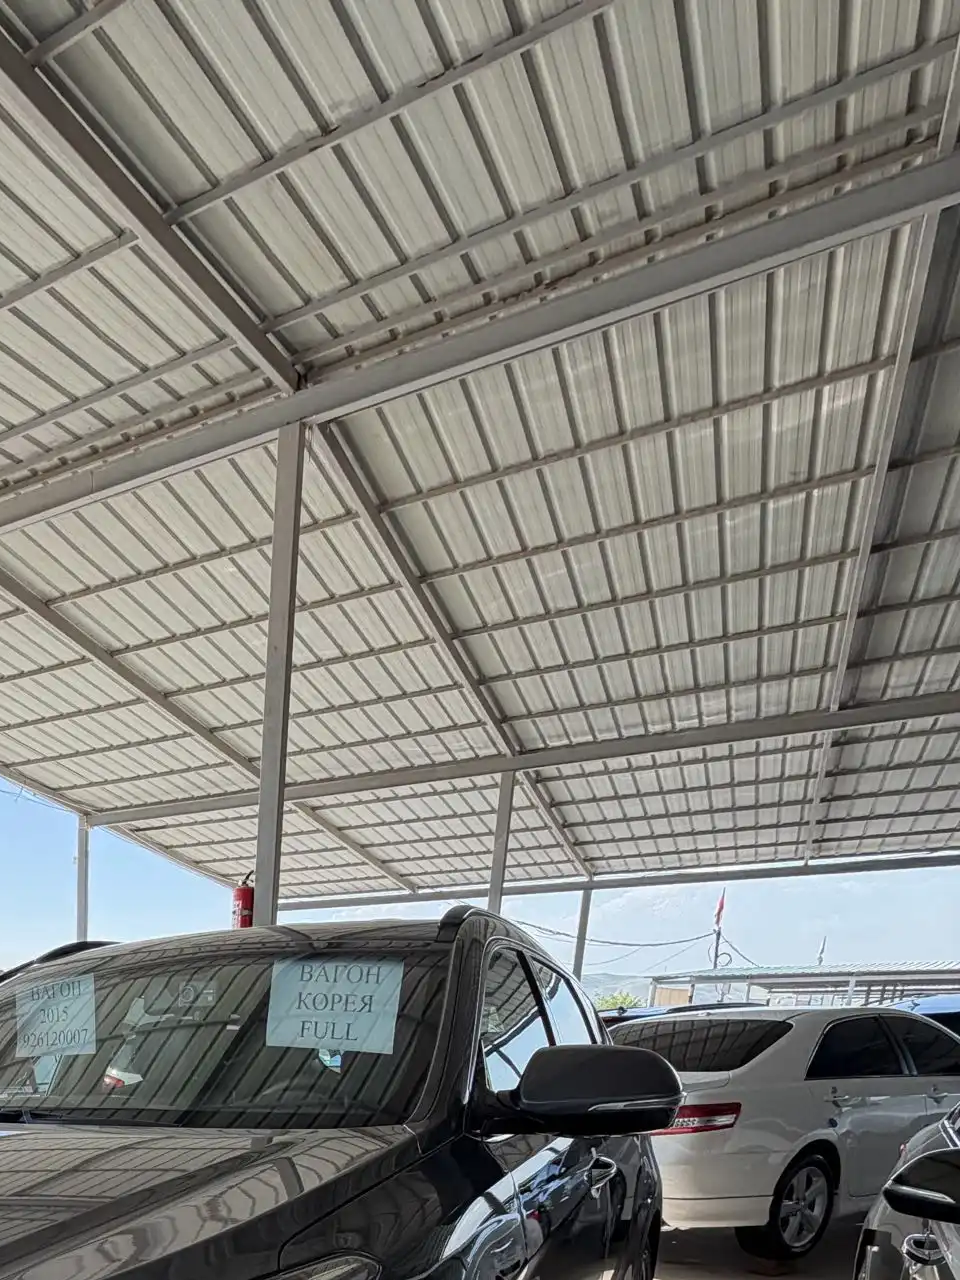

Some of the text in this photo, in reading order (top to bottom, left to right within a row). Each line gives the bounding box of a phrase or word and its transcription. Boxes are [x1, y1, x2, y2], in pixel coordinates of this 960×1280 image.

[299, 963, 382, 985] ВАГОН
[295, 991, 375, 1014] КОРЕЯ
[39, 1005, 69, 1024] 2015
[22, 1027, 89, 1049] 926120007
[299, 1019, 358, 1041] FULL
